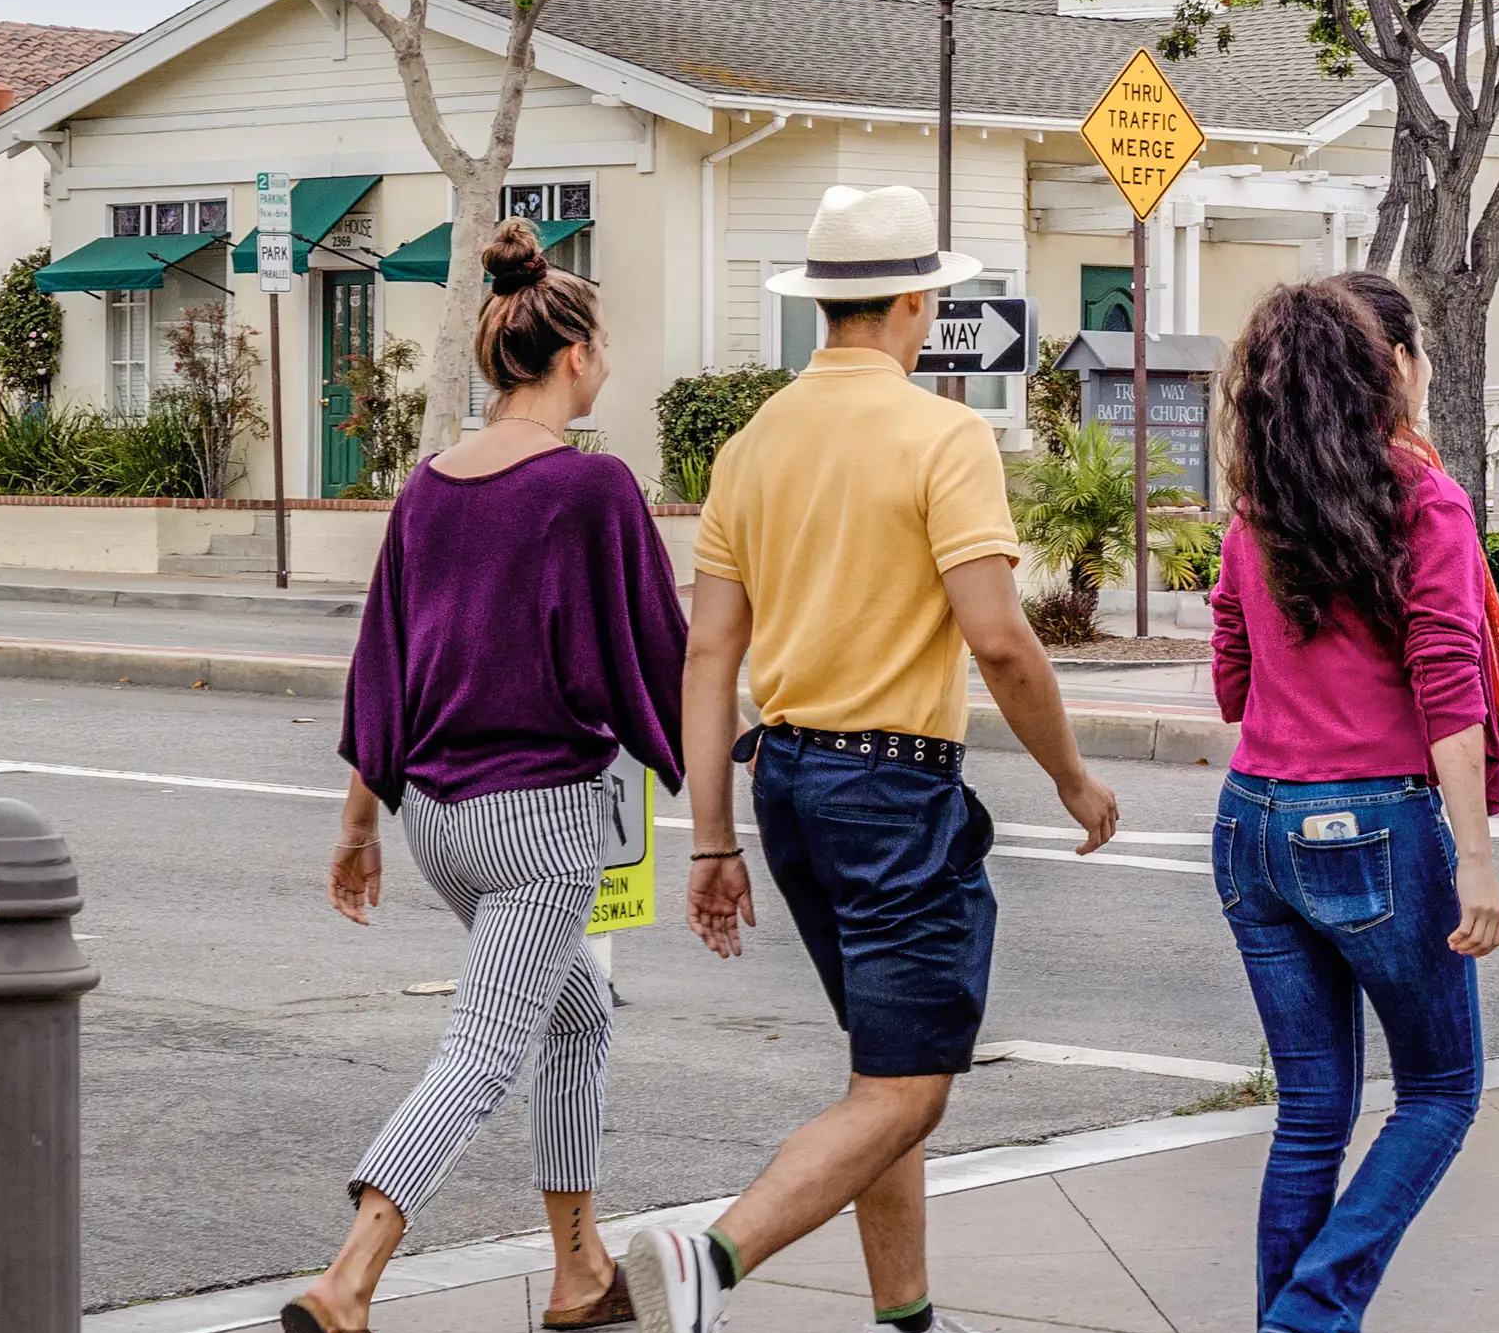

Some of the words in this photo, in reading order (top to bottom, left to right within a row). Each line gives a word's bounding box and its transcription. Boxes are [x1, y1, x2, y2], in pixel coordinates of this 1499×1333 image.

[1122, 82, 1163, 103] THRU
[1108, 109, 1177, 132] TRAFFIC
[1111, 137, 1175, 159] MERGE
[258, 175, 267, 188] 2
[1121, 166, 1166, 187] LEFT
[260, 193, 287, 205] PARKING
[344, 219, 373, 238] HOUSE
[332, 236, 351, 248] 2369
[262, 246, 288, 261] PARK
[261, 269, 288, 279] PARALLEL
[940, 322, 982, 350] WAY
[1160, 384, 1187, 401] WAY
[1098, 404, 1136, 421] BAPTI
[1150, 406, 1205, 424] CHURCH
[600, 876, 629, 897] THIN
[591, 898, 644, 923] SSWALK
